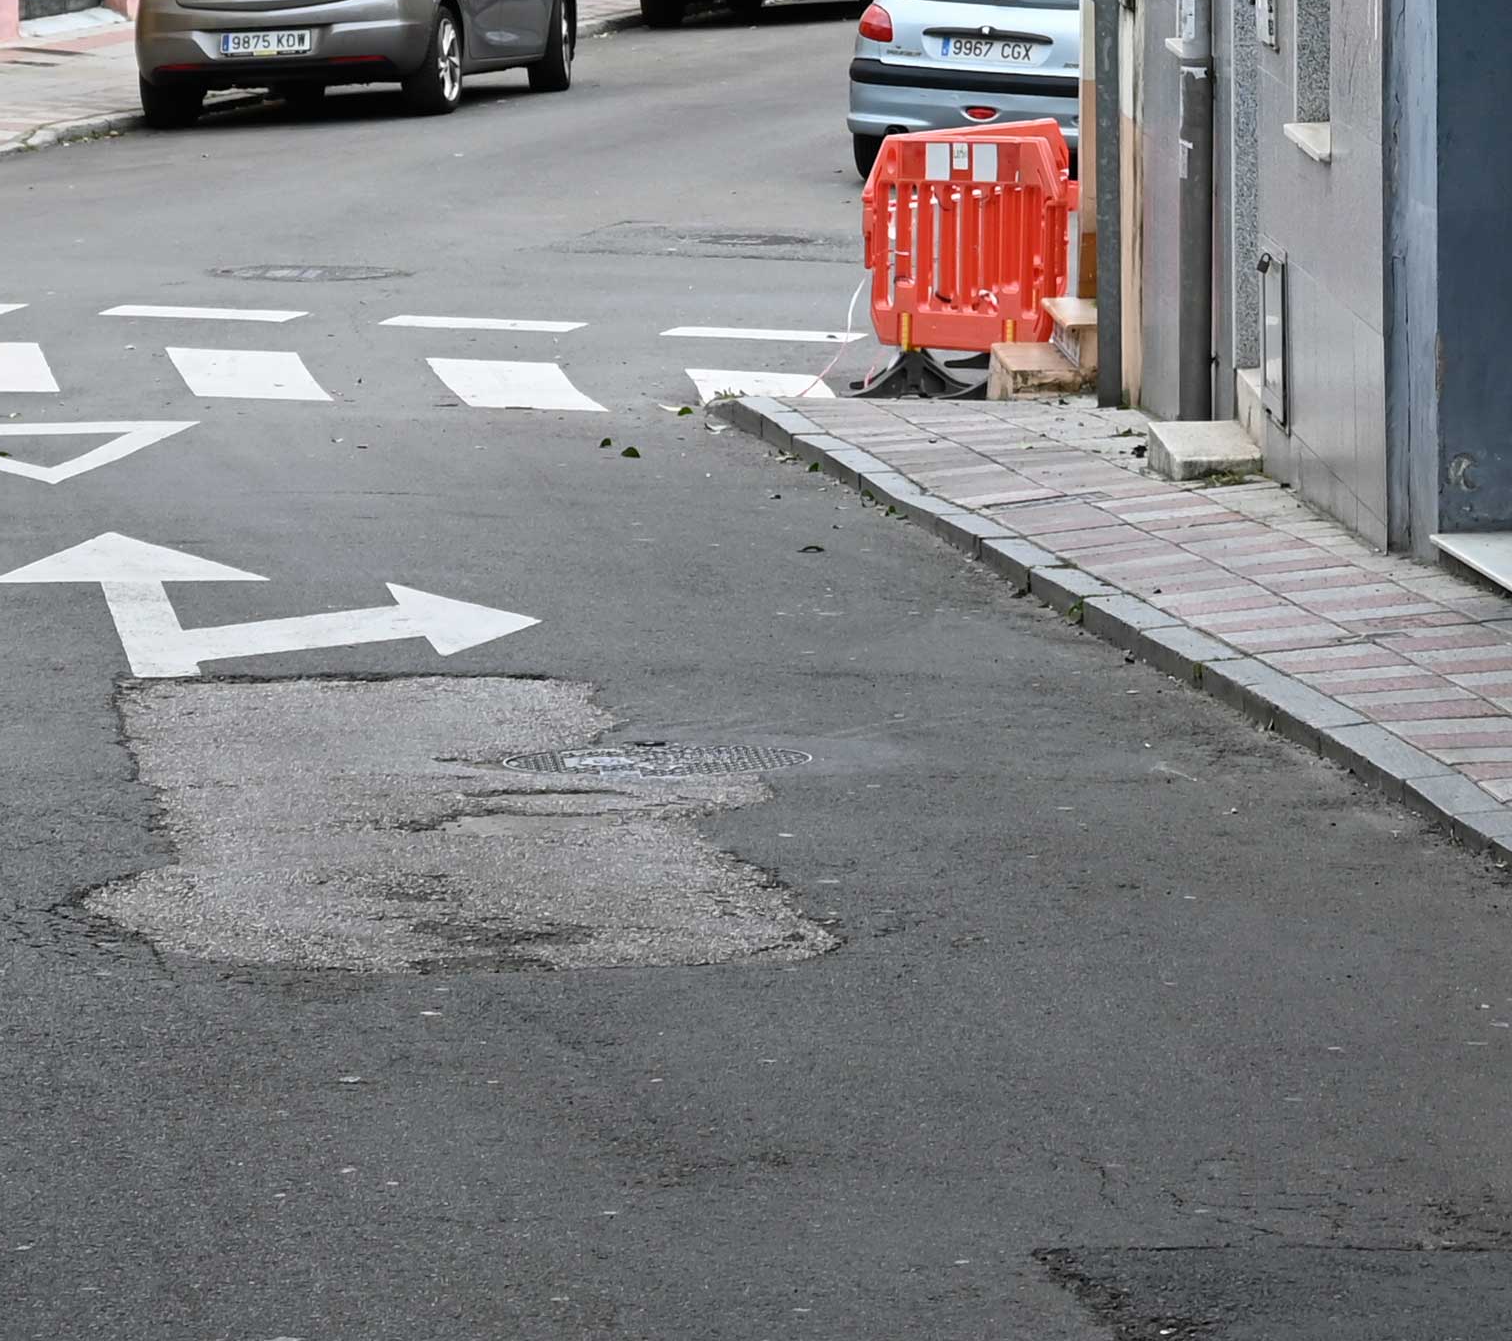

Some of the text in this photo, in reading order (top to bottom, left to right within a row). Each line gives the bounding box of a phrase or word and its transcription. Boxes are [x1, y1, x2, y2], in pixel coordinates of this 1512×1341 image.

[231, 32, 306, 50] 9875 KDW
[952, 39, 1034, 62] 9967 CGX
